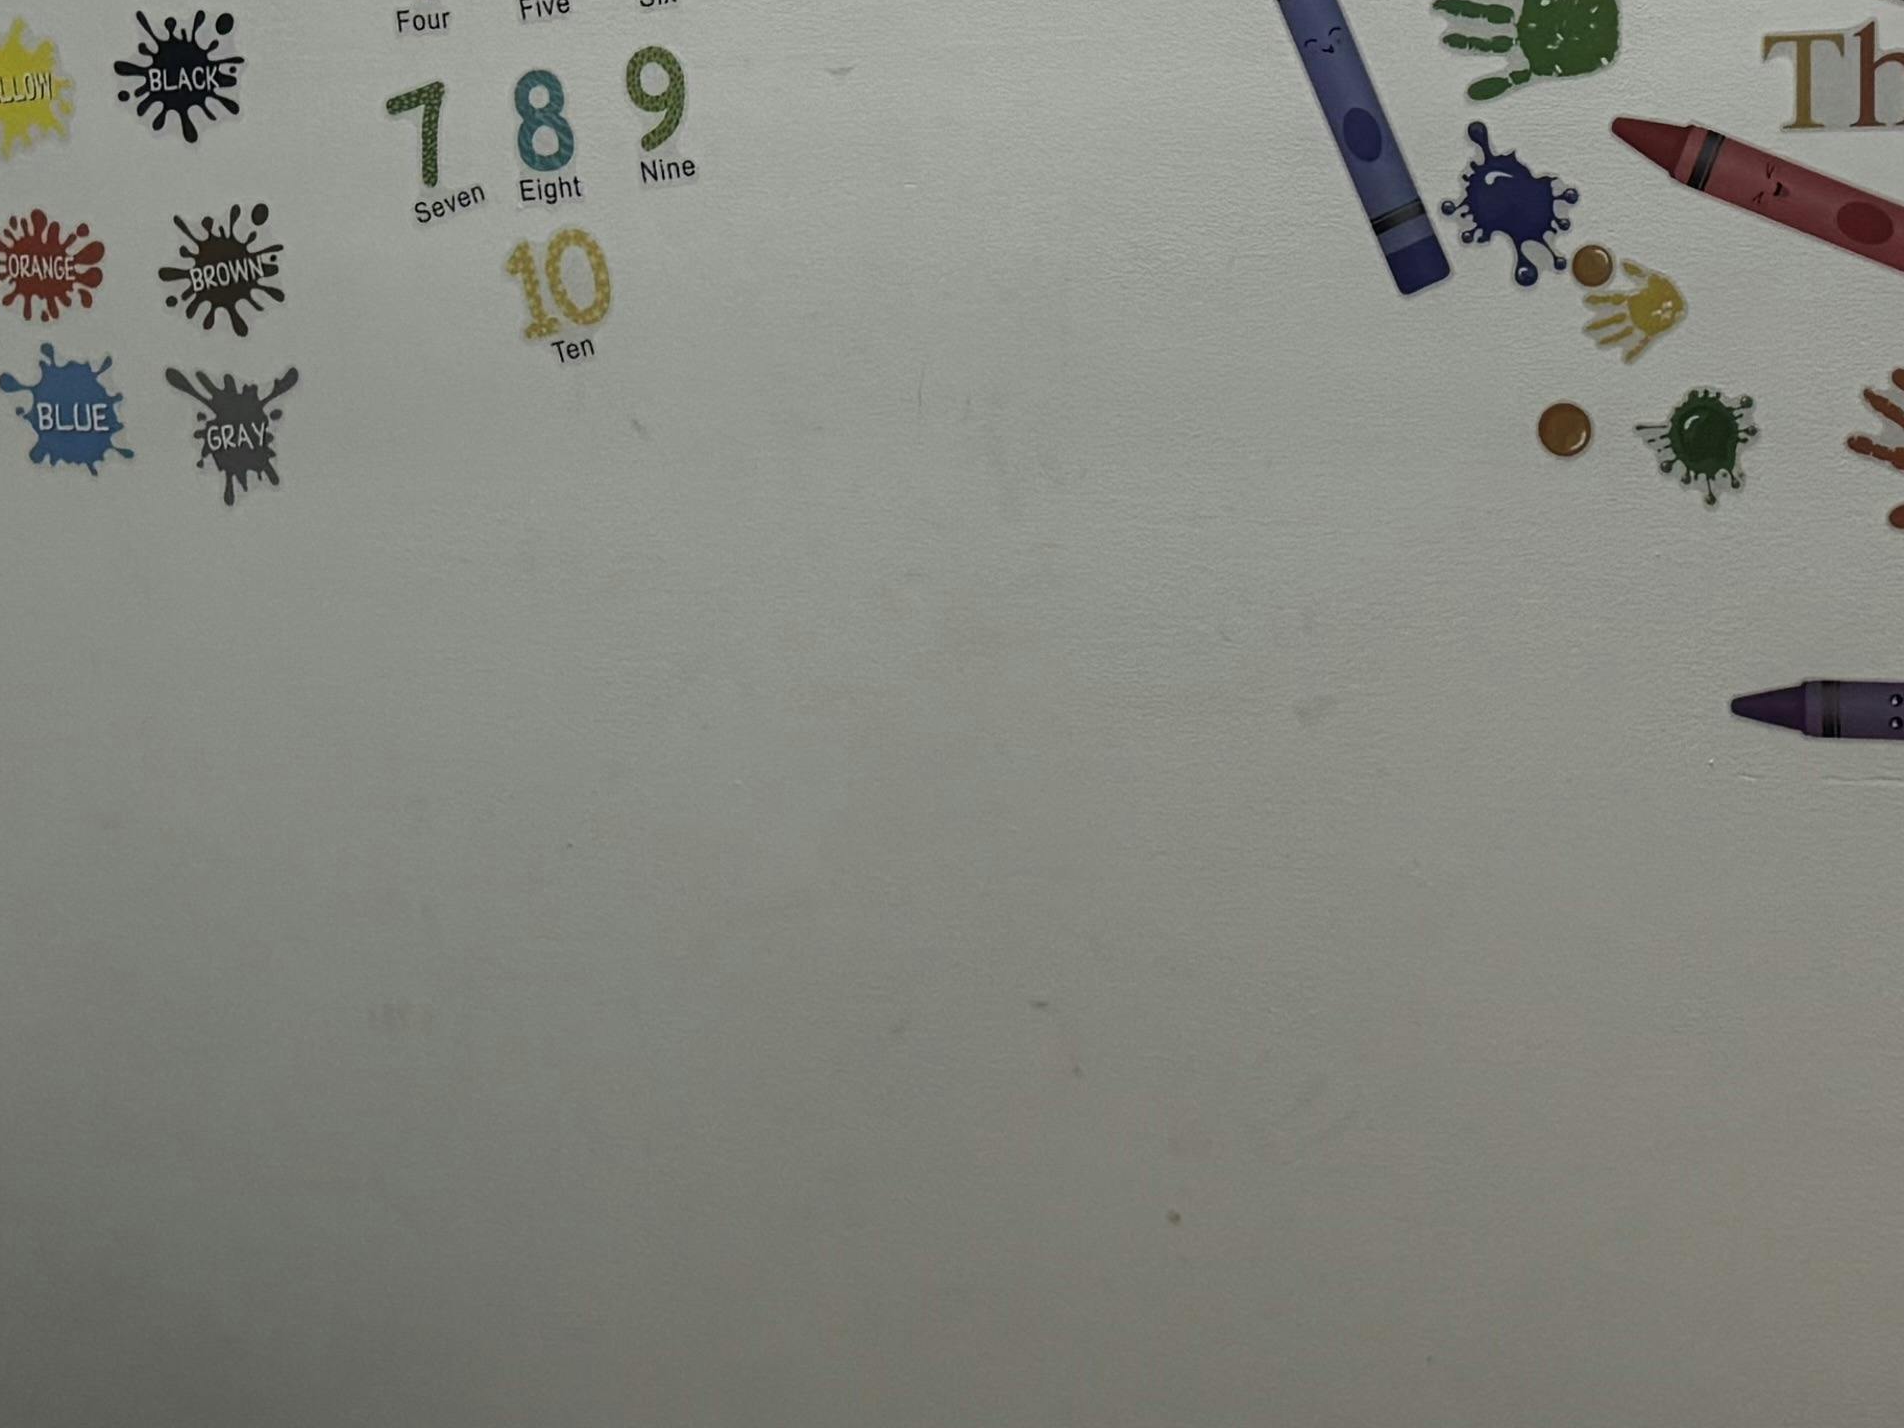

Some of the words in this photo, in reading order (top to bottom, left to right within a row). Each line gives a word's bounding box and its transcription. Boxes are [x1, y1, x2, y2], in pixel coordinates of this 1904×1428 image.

[397, 9, 450, 33] Four
[148, 66, 221, 92] BLACK
[626, 45, 685, 152] 9
[386, 80, 445, 189] 7
[514, 70, 574, 172] 8
[640, 158, 696, 184] Nine
[414, 184, 486, 224] Seven
[519, 176, 582, 205] Eight
[8, 254, 77, 282] ORANGE
[188, 256, 265, 293] BROWN
[505, 228, 611, 339] 10
[551, 337, 595, 363] Ten
[36, 403, 110, 432] BLUE
[207, 421, 267, 451] GRAY
